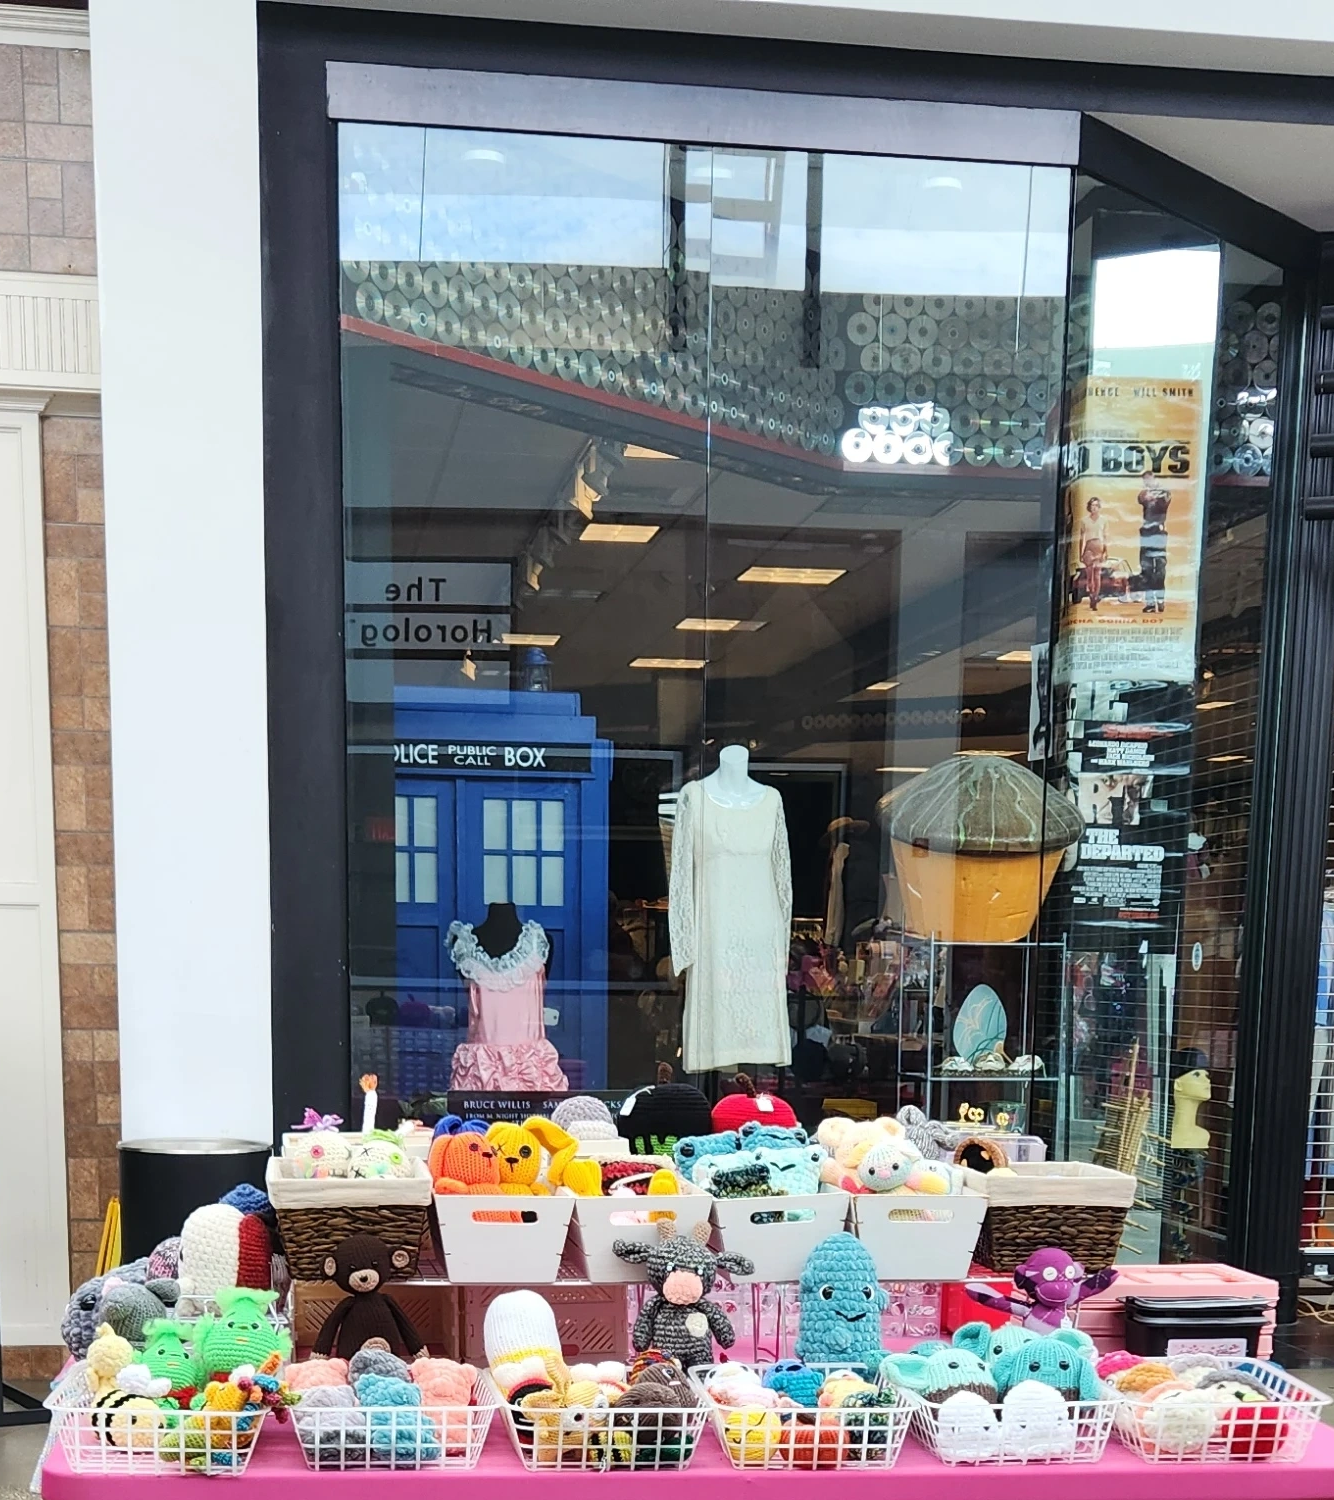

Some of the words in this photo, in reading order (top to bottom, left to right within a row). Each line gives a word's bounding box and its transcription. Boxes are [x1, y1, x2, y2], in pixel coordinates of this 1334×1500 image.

[1133, 388, 1157, 397] WILL
[1163, 388, 1193, 397] SMITH
[1101, 444, 1190, 474] BOYS
[448, 744, 497, 756] PUBLIC
[504, 746, 546, 767] BOX
[453, 755, 491, 766] CALL
[1085, 828, 1120, 844] THE
[1080, 843, 1165, 862] DEPARTED
[463, 1100, 495, 1109] BRUCE
[497, 1100, 531, 1109] WILLIS
